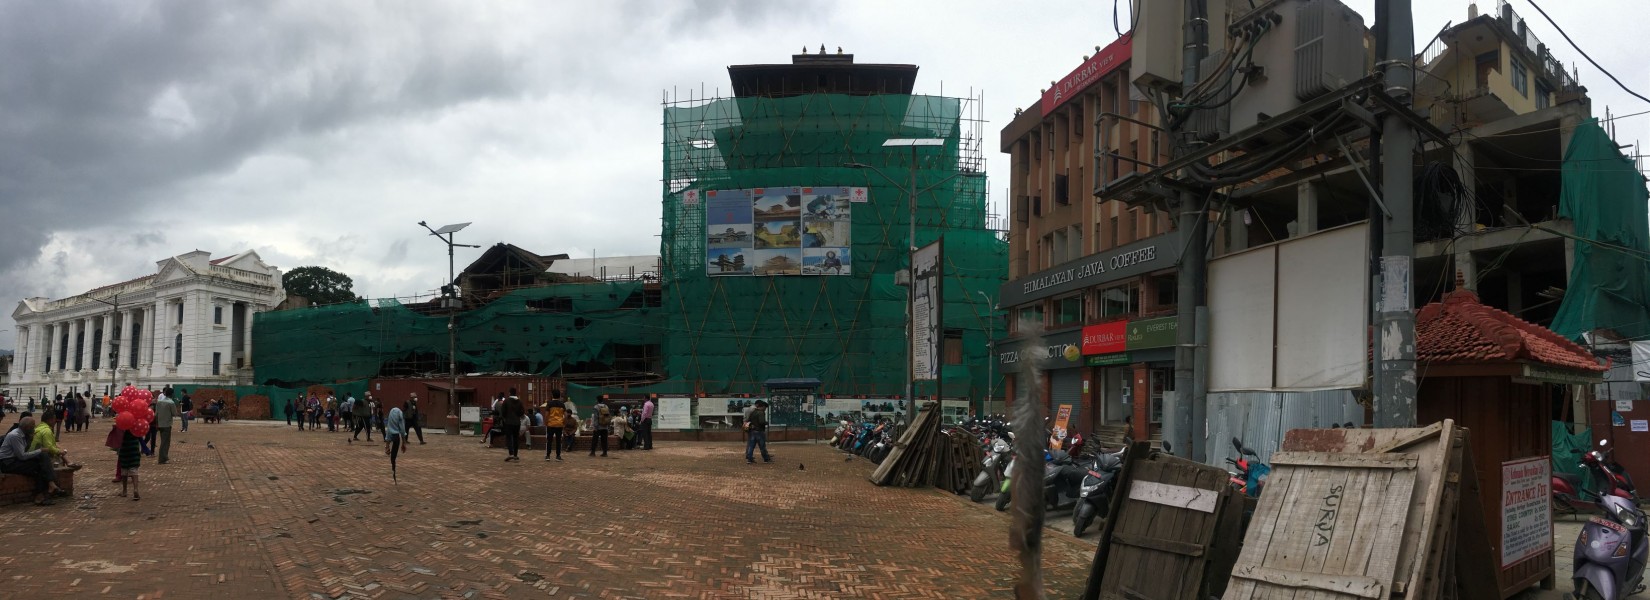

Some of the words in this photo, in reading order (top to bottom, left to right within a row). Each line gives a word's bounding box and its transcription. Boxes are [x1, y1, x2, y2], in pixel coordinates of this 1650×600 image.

[1063, 62, 1097, 93] DURBAR
[1023, 268, 1075, 294] HIMALAYAN
[1077, 260, 1105, 280] JAVA
[1110, 245, 1157, 271] COFFEE
[1146, 323, 1168, 333] EVEREST
[1089, 332, 1114, 344] DURBAR
[1000, 350, 1019, 364] PIZZA
[1505, 488, 1537, 506] ENTRANCE
[1537, 483, 1548, 498] FEE
